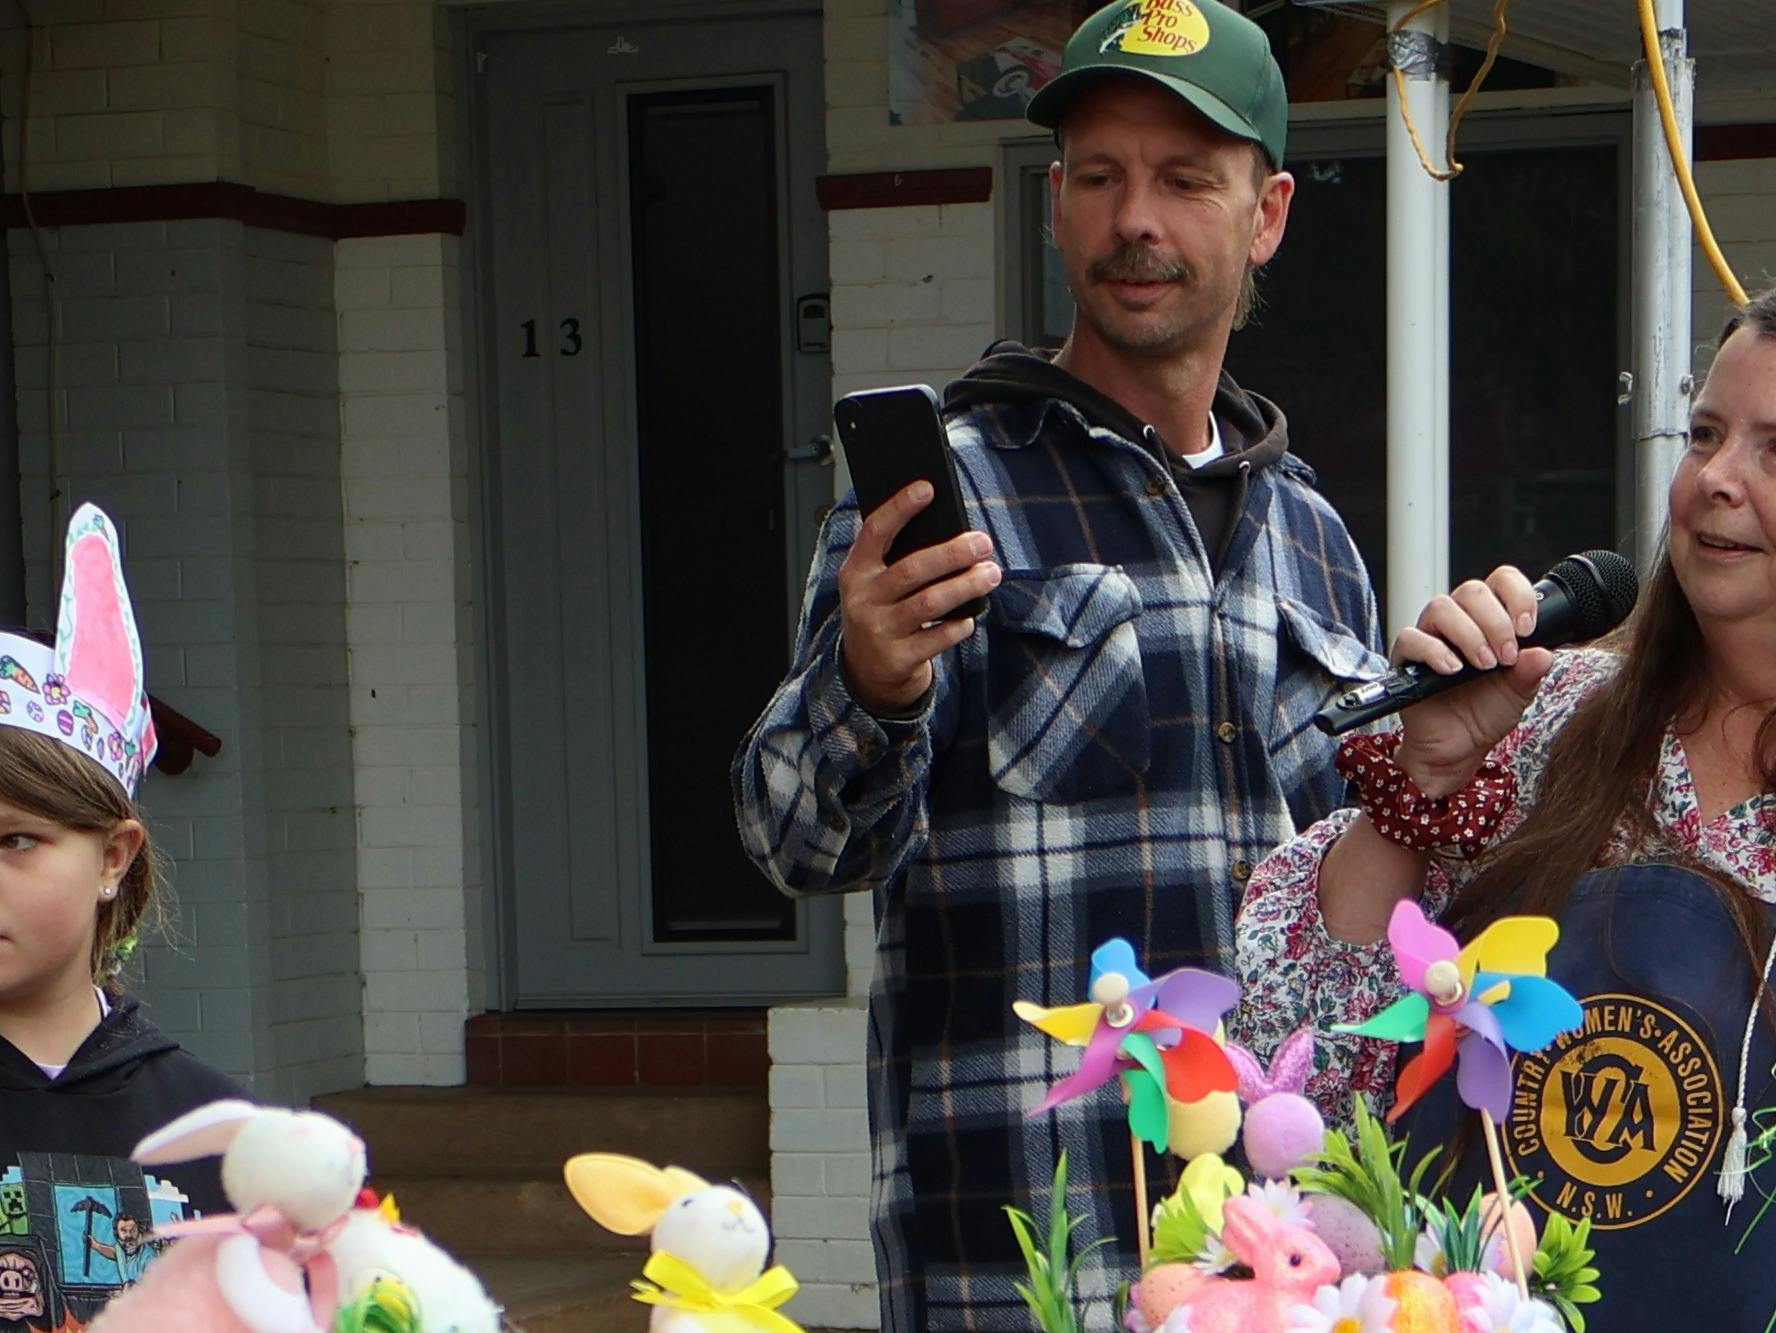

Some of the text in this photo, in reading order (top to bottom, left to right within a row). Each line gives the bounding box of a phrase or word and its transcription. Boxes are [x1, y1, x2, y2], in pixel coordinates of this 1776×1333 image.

[1137, 25, 1197, 51] Shops
[1142, 9, 1178, 28] Pro
[521, 318, 583, 358] 13
[1657, 1028, 1714, 1184] ASSOCIATION
[1556, 1181, 1633, 1220] N.S.W.
